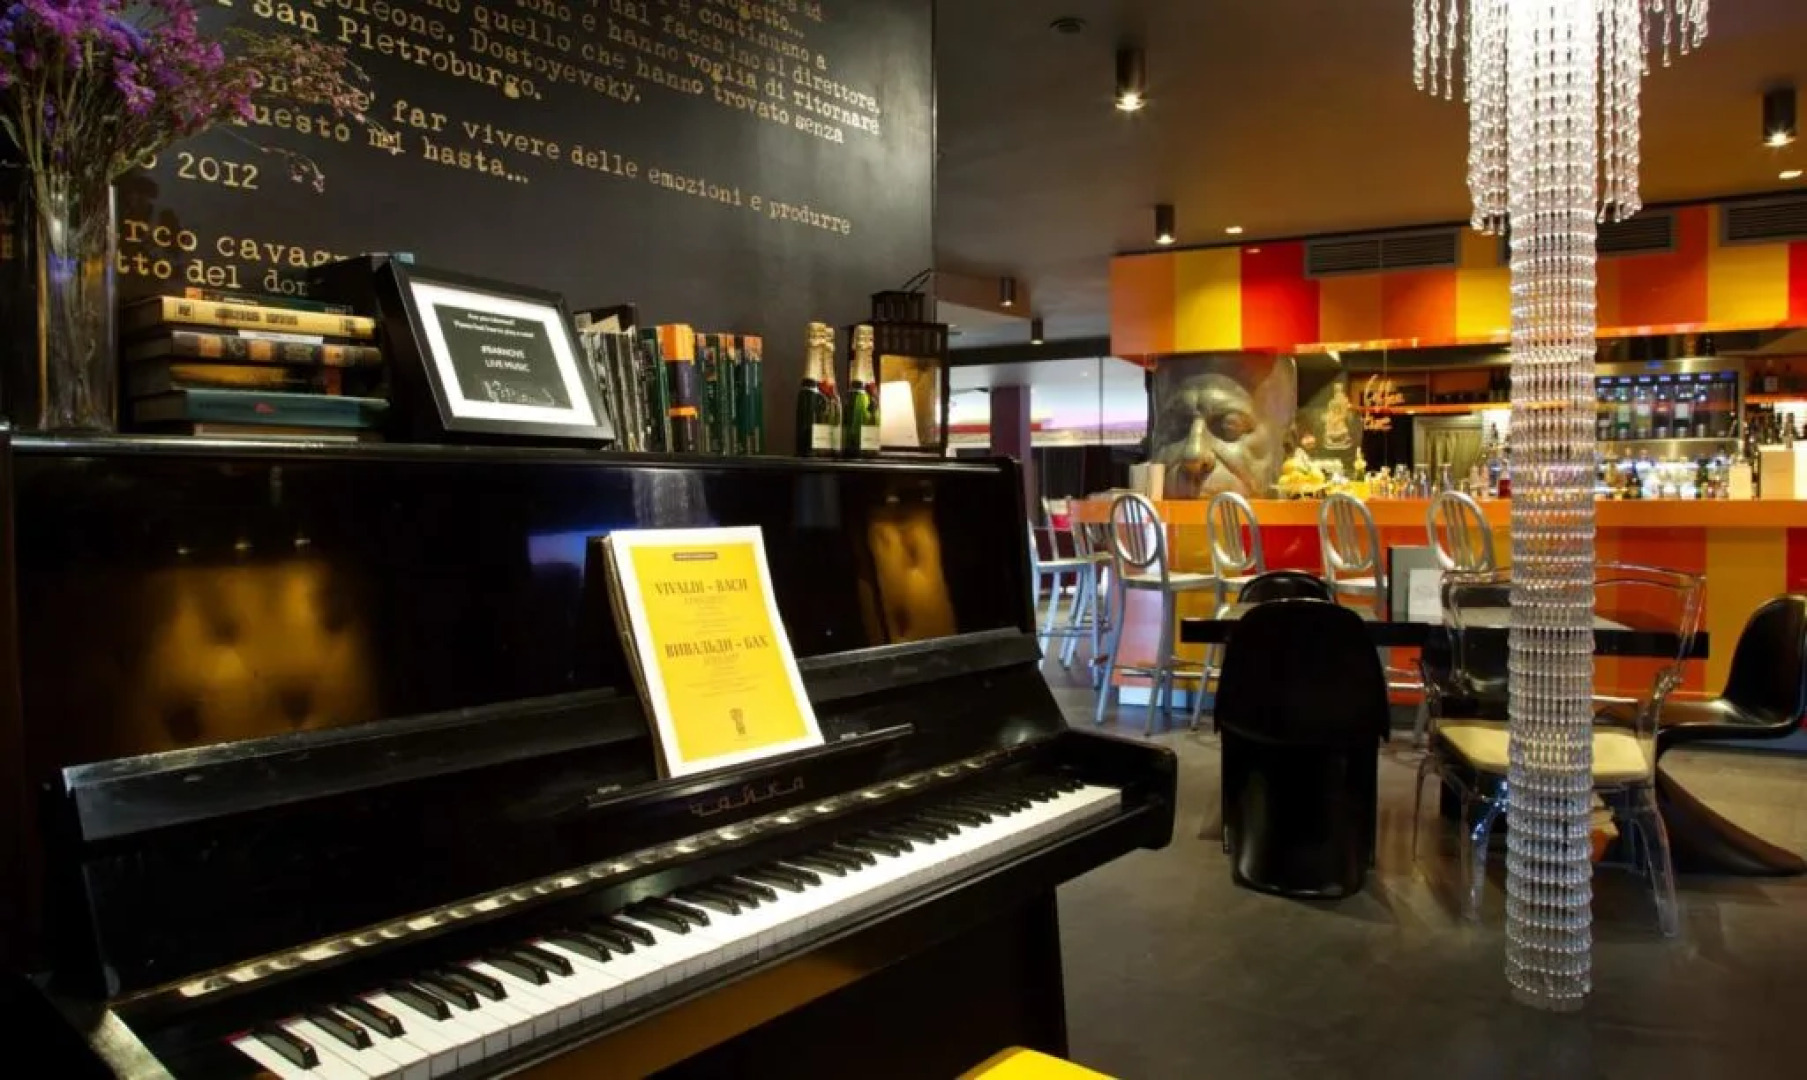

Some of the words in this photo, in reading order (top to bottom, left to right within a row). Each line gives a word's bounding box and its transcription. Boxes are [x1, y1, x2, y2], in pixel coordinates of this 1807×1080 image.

[338, 15, 541, 100] Pietroburgo.
[474, 5, 571, 52] quello
[636, 56, 703, 94] hanno
[713, 85, 790, 125] trovato
[795, 114, 844, 144] senza
[581, 14, 596, 31] e
[607, 17, 679, 62] hanno
[765, 77, 785, 100] di
[793, 89, 880, 135] ritornare
[764, 56, 785, 77] al
[793, 63, 880, 114] direttore,
[816, 55, 826, 71] a
[232, 103, 351, 142] uesto
[177, 151, 259, 190] 2012
[392, 100, 448, 132] far
[462, 120, 560, 160] vivere
[571, 145, 639, 179] delle
[648, 166, 742, 206] emozioni
[750, 194, 763, 212] e
[769, 199, 851, 236] produrre
[186, 258, 242, 290] del
